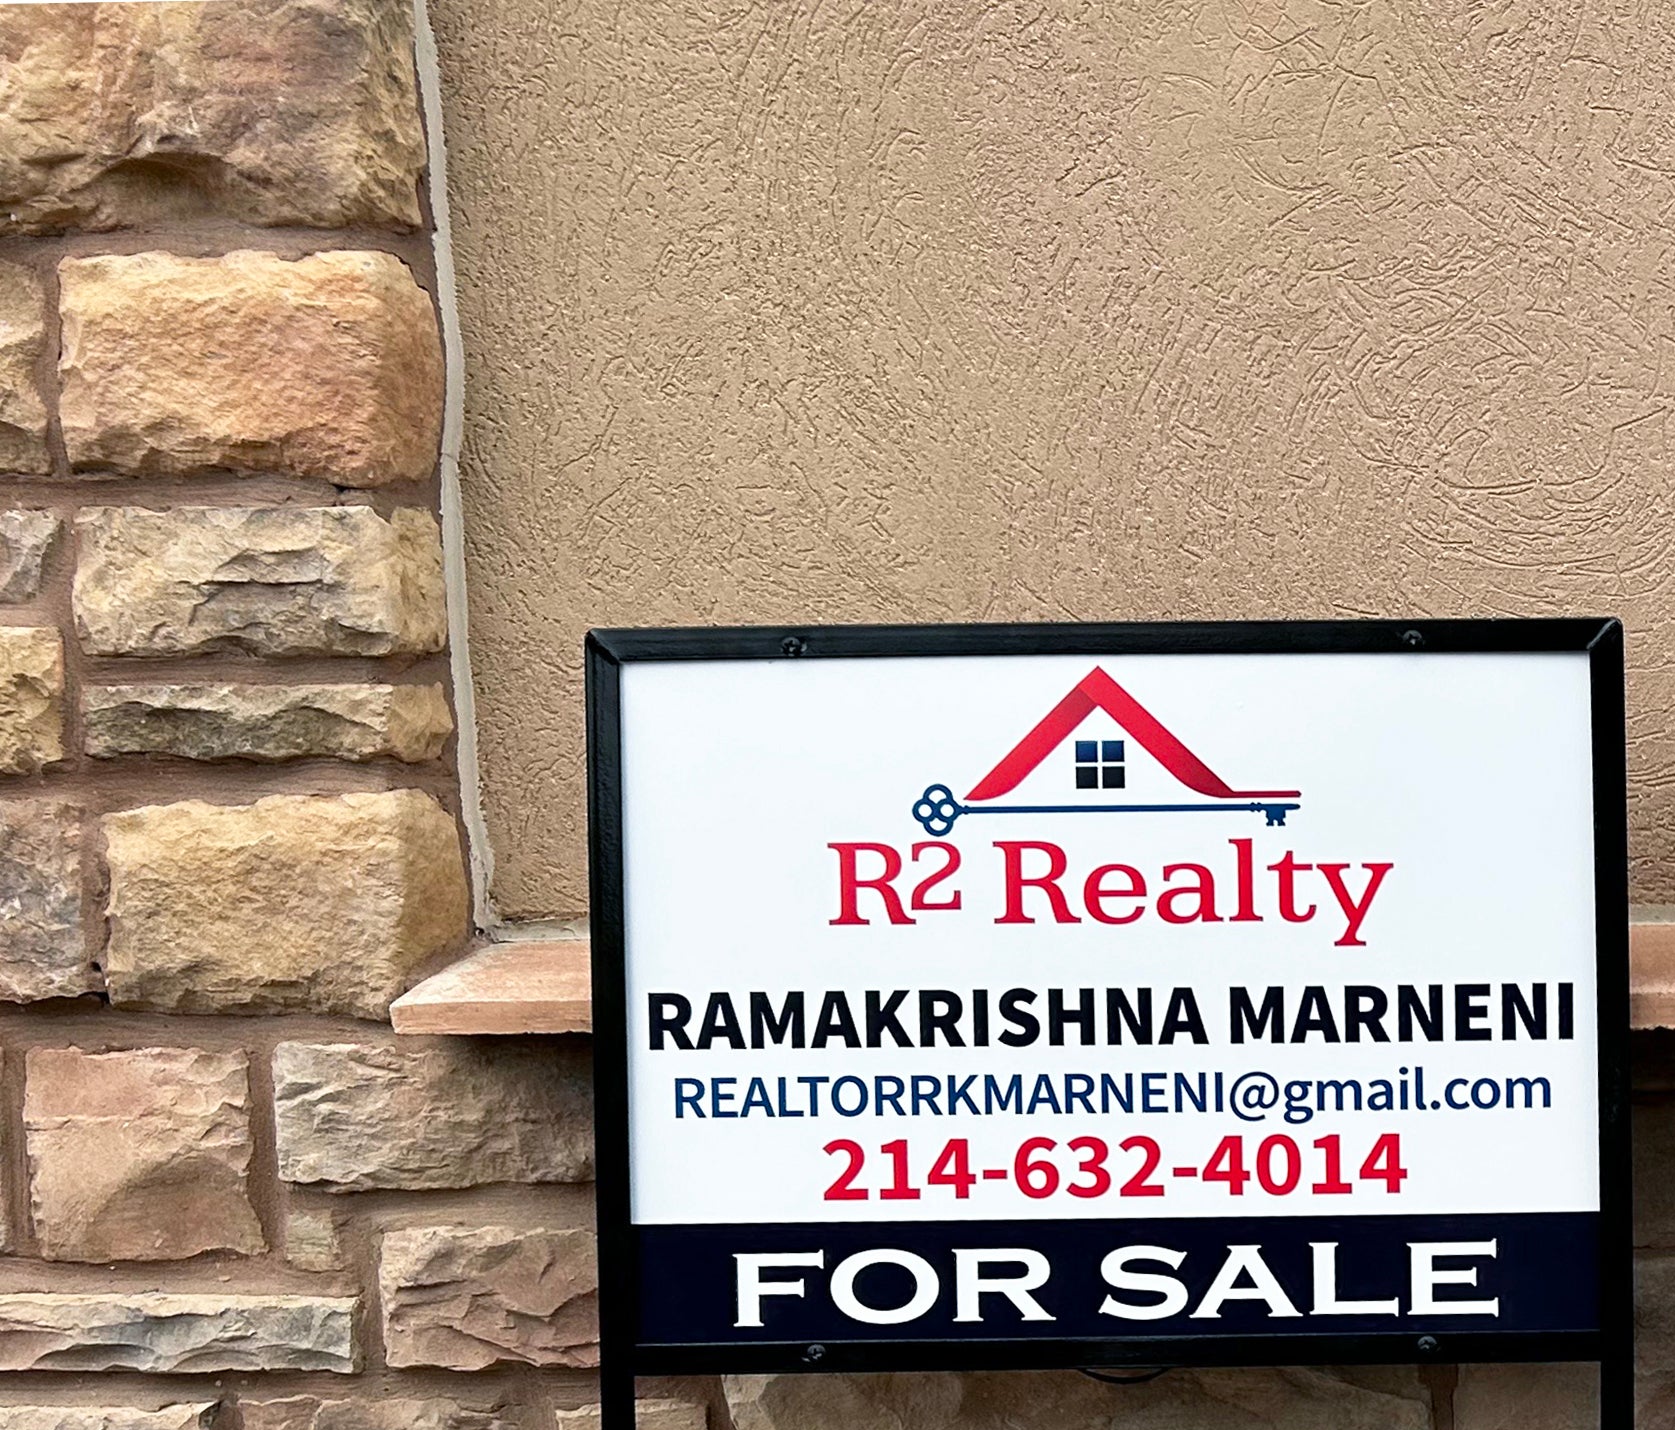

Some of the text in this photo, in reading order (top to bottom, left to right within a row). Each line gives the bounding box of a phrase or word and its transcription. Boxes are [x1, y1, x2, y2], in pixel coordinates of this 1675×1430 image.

[828, 837, 1393, 947] R2 Realty
[647, 982, 1574, 1051] RAMAKRISHNA MARNENI
[674, 1066, 1552, 1125] REALTORRKMARNENI@gmail.com
[823, 1132, 1408, 1201] 214-632-4014
[732, 1237, 1499, 1327] FOR SALE
